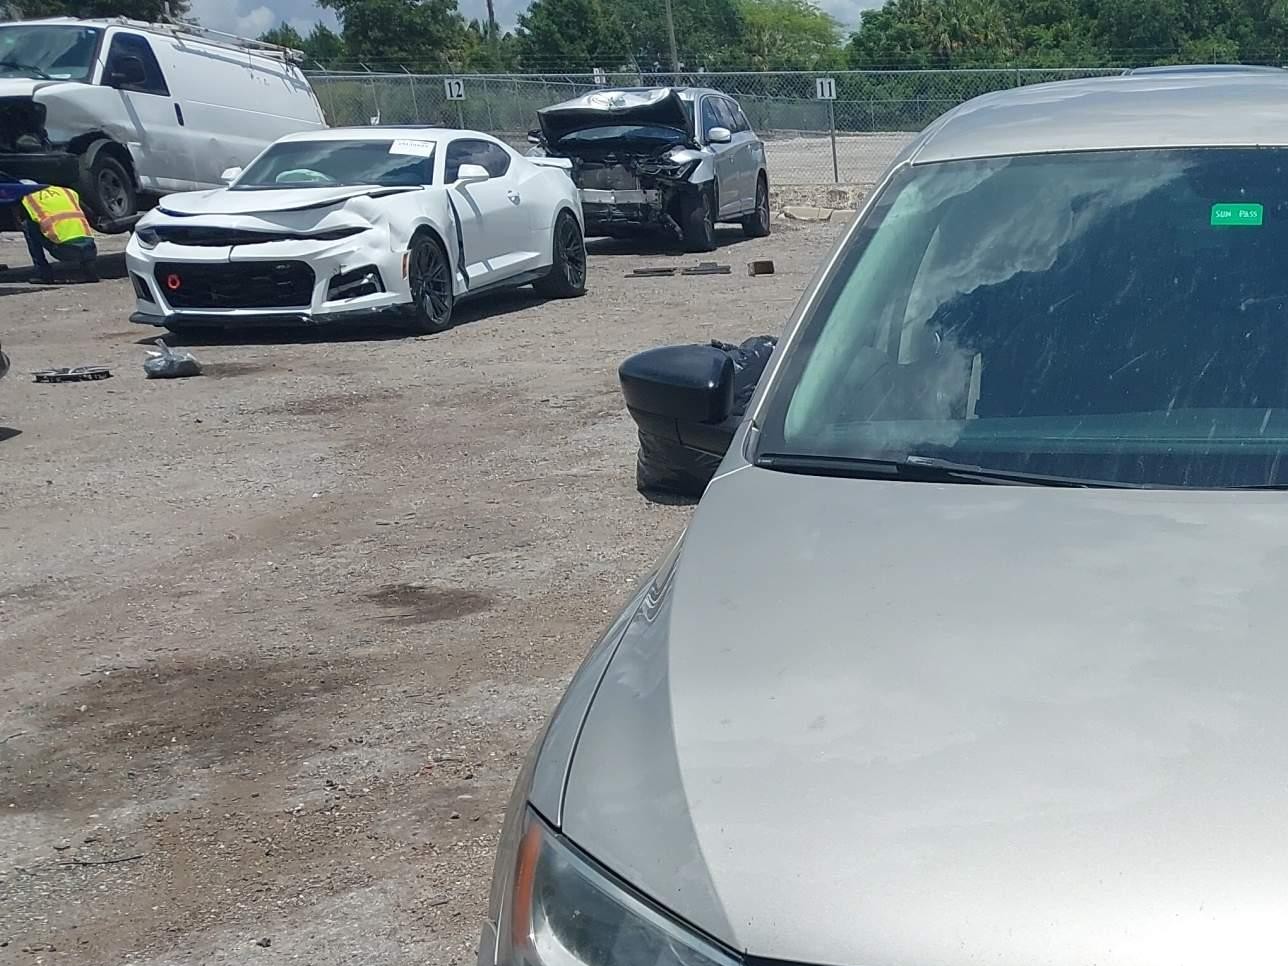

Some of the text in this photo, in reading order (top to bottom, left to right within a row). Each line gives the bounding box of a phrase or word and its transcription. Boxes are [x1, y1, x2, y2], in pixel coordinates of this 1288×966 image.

[447, 81, 463, 98] 12
[819, 80, 834, 98] 11
[1215, 209, 1258, 218] SUN PASS
